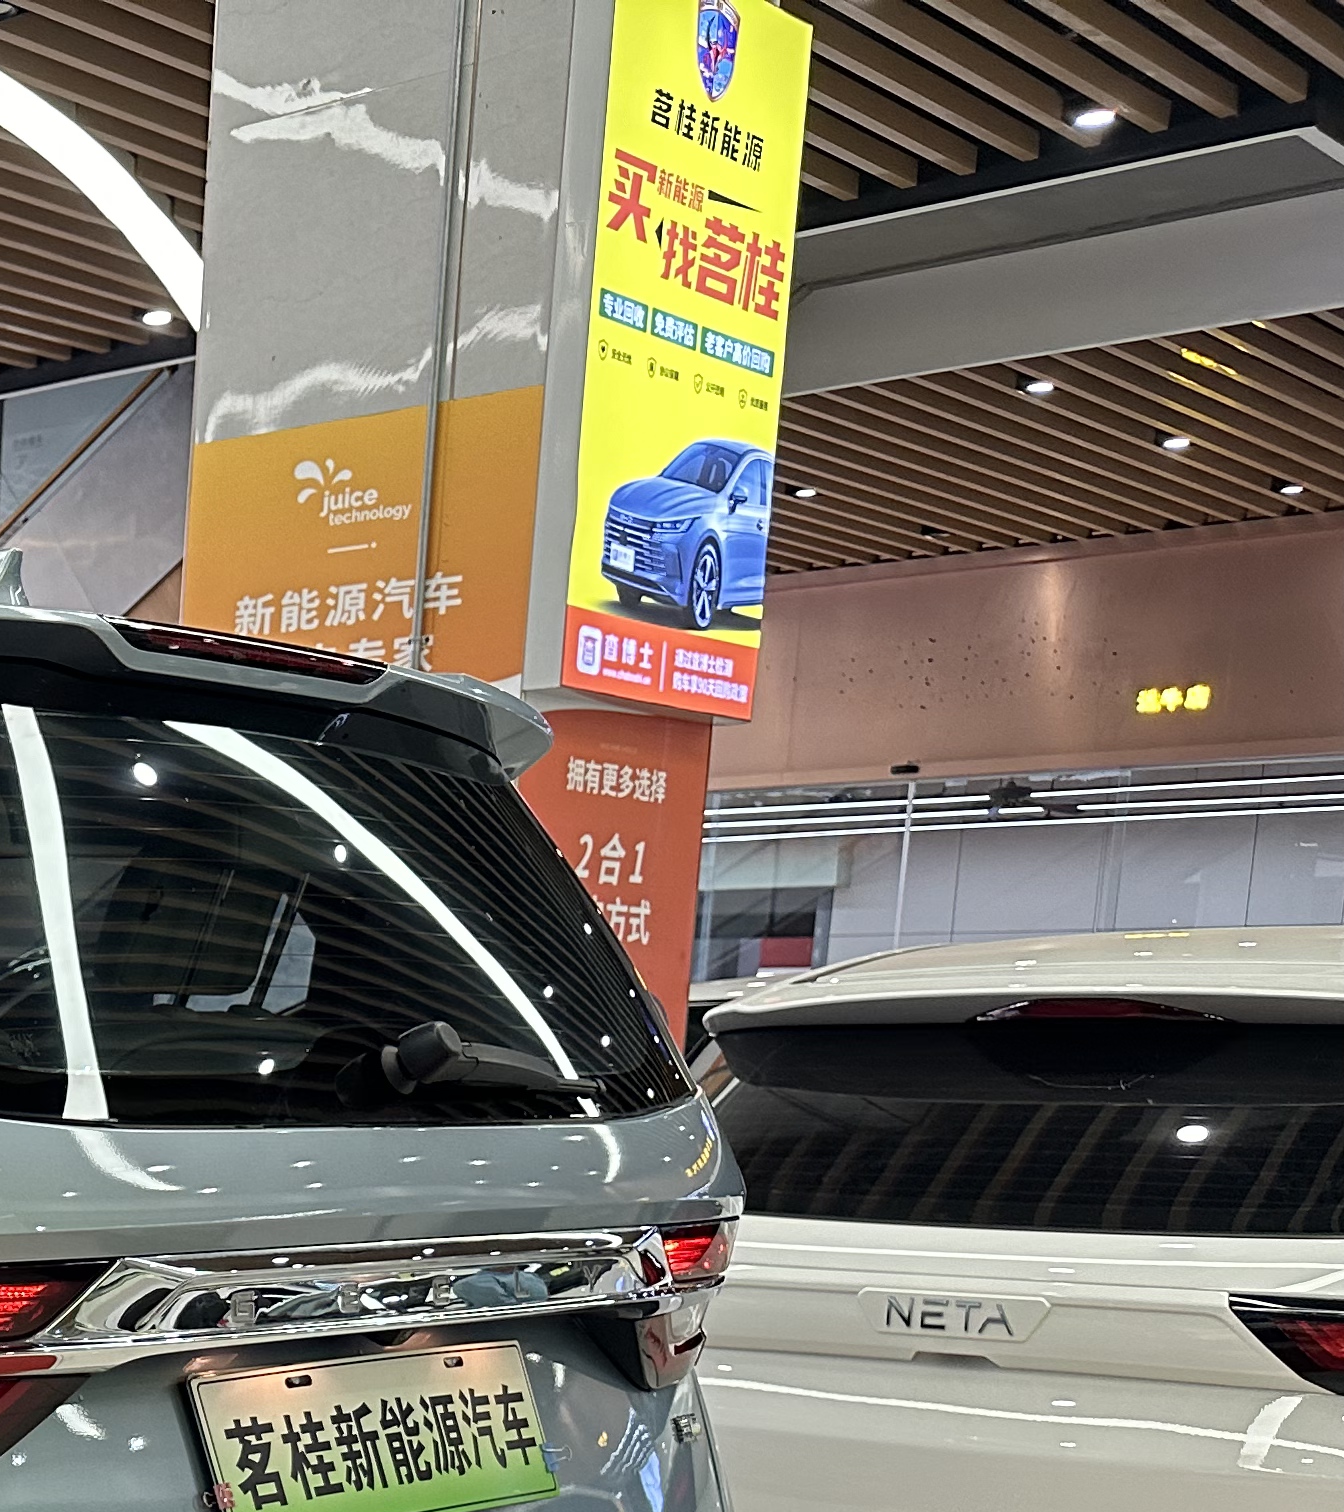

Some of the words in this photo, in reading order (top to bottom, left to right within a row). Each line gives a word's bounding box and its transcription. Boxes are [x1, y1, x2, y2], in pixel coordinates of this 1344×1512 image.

[650, 88, 765, 173] 茗桂新能源
[605, 147, 659, 244] 买
[656, 168, 706, 213] 新能源
[660, 215, 786, 322] 找茗桂
[602, 292, 646, 329] 专业回收
[319, 487, 379, 517] juice
[328, 503, 412, 527] technology
[233, 571, 463, 636] 新能源汽车
[566, 755, 668, 804] 拥有更多选择
[885, 1295, 1015, 1337] NETA
[224, 1383, 538, 1512] 茗桂新能源汽车
